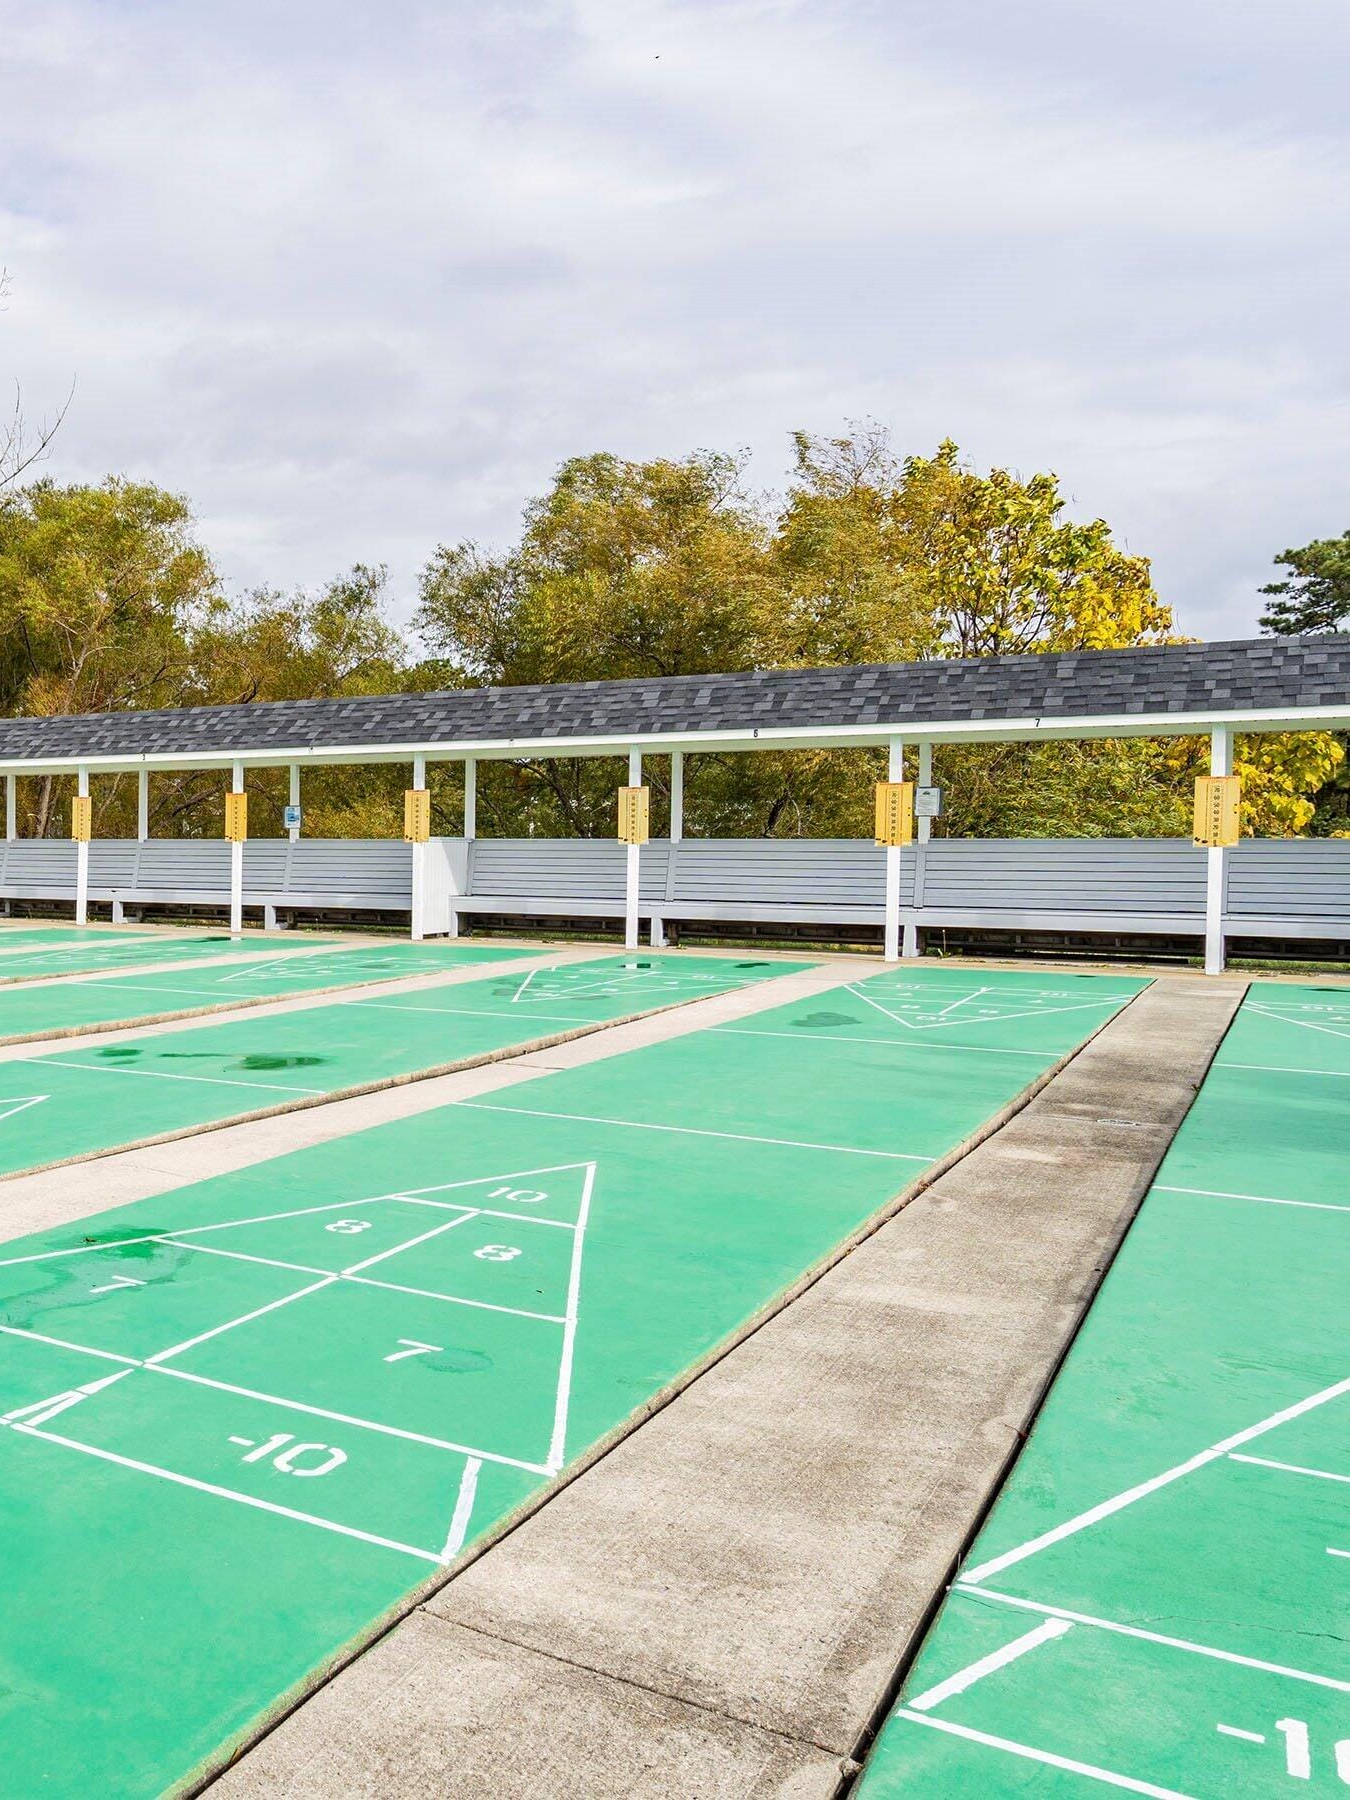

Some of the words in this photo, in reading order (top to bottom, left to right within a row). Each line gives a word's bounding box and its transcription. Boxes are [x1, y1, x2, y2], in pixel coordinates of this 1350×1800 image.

[487, 1187, 549, 1203] 10
[325, 1218, 373, 1235] 8
[473, 1244, 523, 1262] 8
[88, 1274, 148, 1295] 7
[383, 1337, 444, 1363] 7
[227, 1432, 349, 1478] -10
